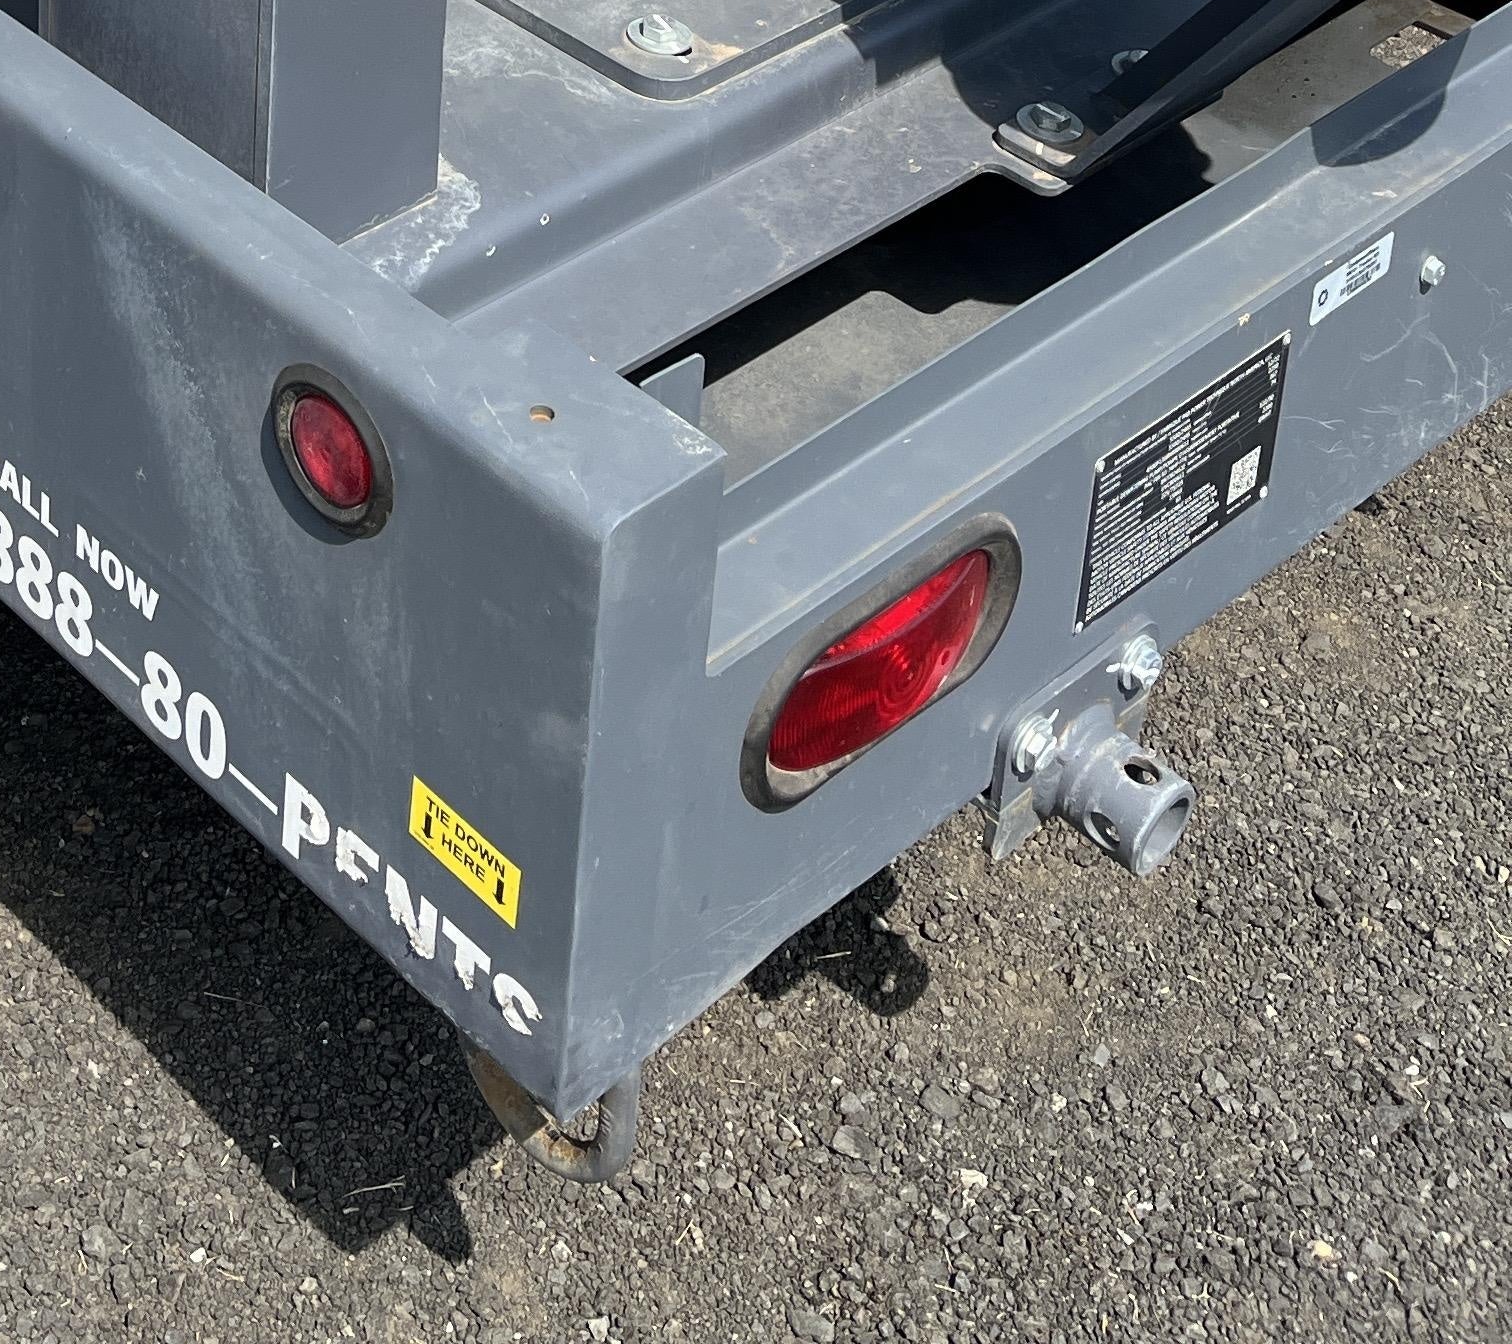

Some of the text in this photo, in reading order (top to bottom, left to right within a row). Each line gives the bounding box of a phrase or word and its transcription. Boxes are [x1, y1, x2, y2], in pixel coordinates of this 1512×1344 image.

[76, 523, 160, 622] NOW
[426, 795, 450, 829] TIE
[455, 822, 506, 880] DOWN
[441, 832, 486, 884] HERE
